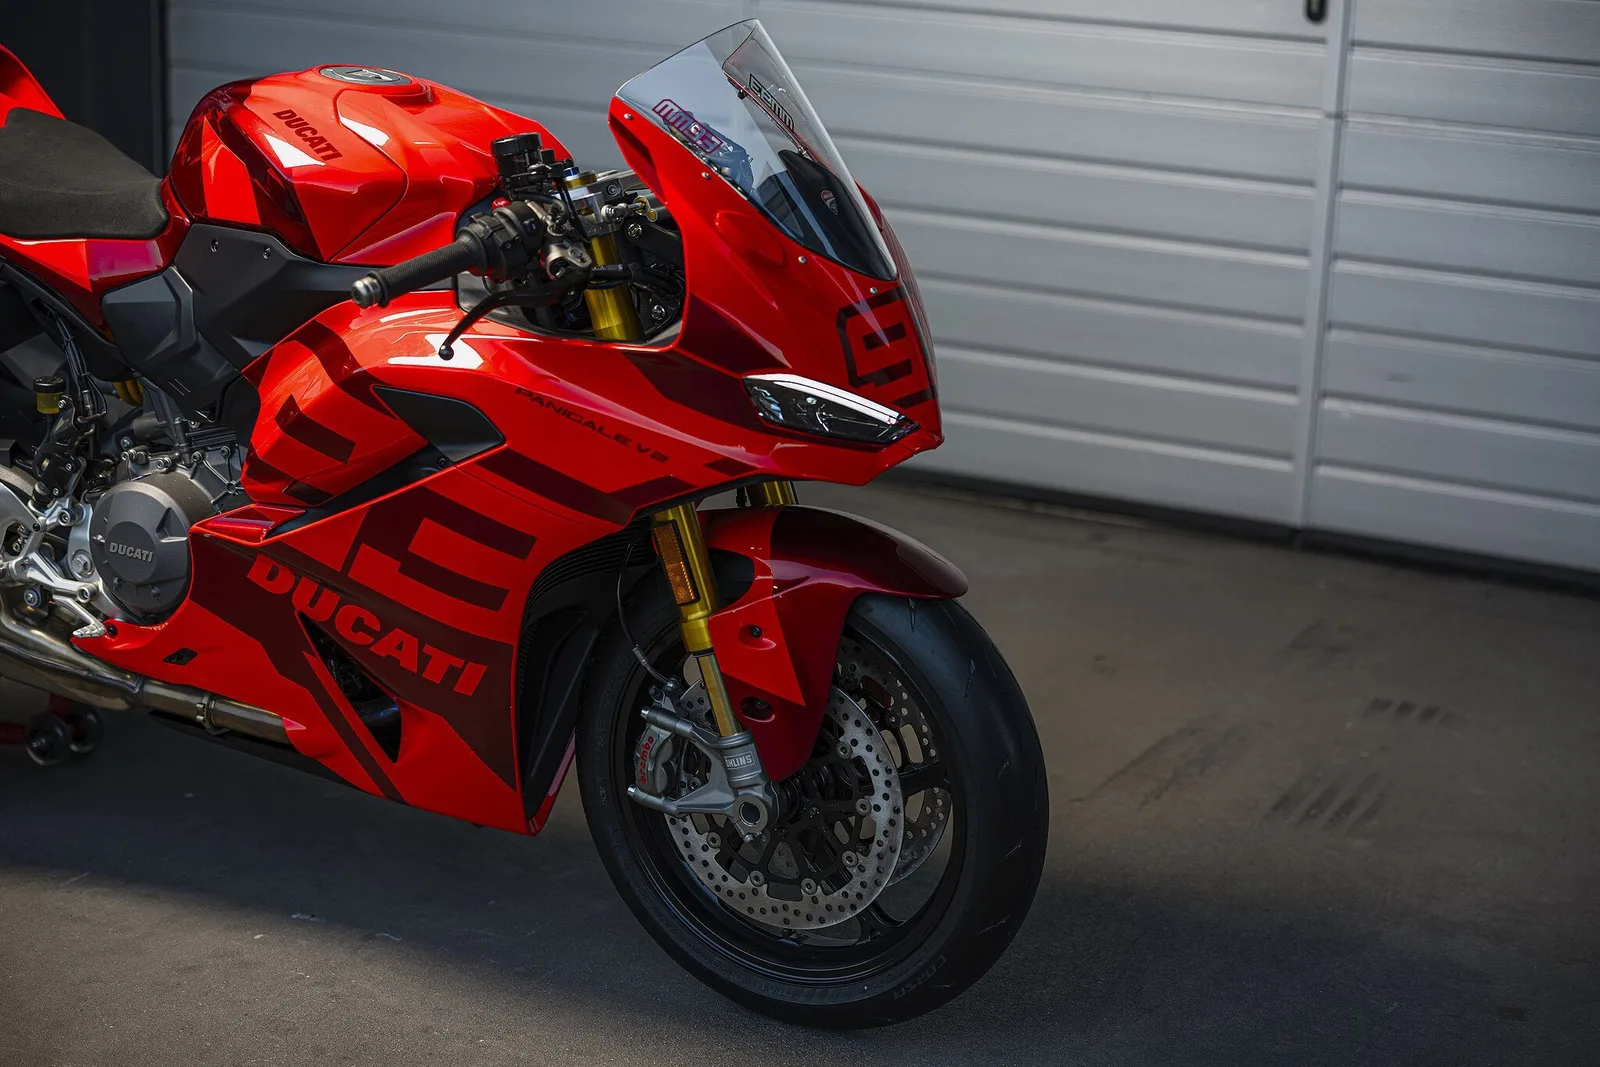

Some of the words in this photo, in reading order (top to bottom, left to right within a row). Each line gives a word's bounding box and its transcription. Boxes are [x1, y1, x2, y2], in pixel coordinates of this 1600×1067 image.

[272, 109, 343, 161] DUCATI
[514, 387, 633, 446] PANIGALE
[637, 444, 669, 463] V2
[109, 542, 153, 562] DUCATI
[247, 553, 488, 697] DUCATI
[639, 736, 654, 785] brembo
